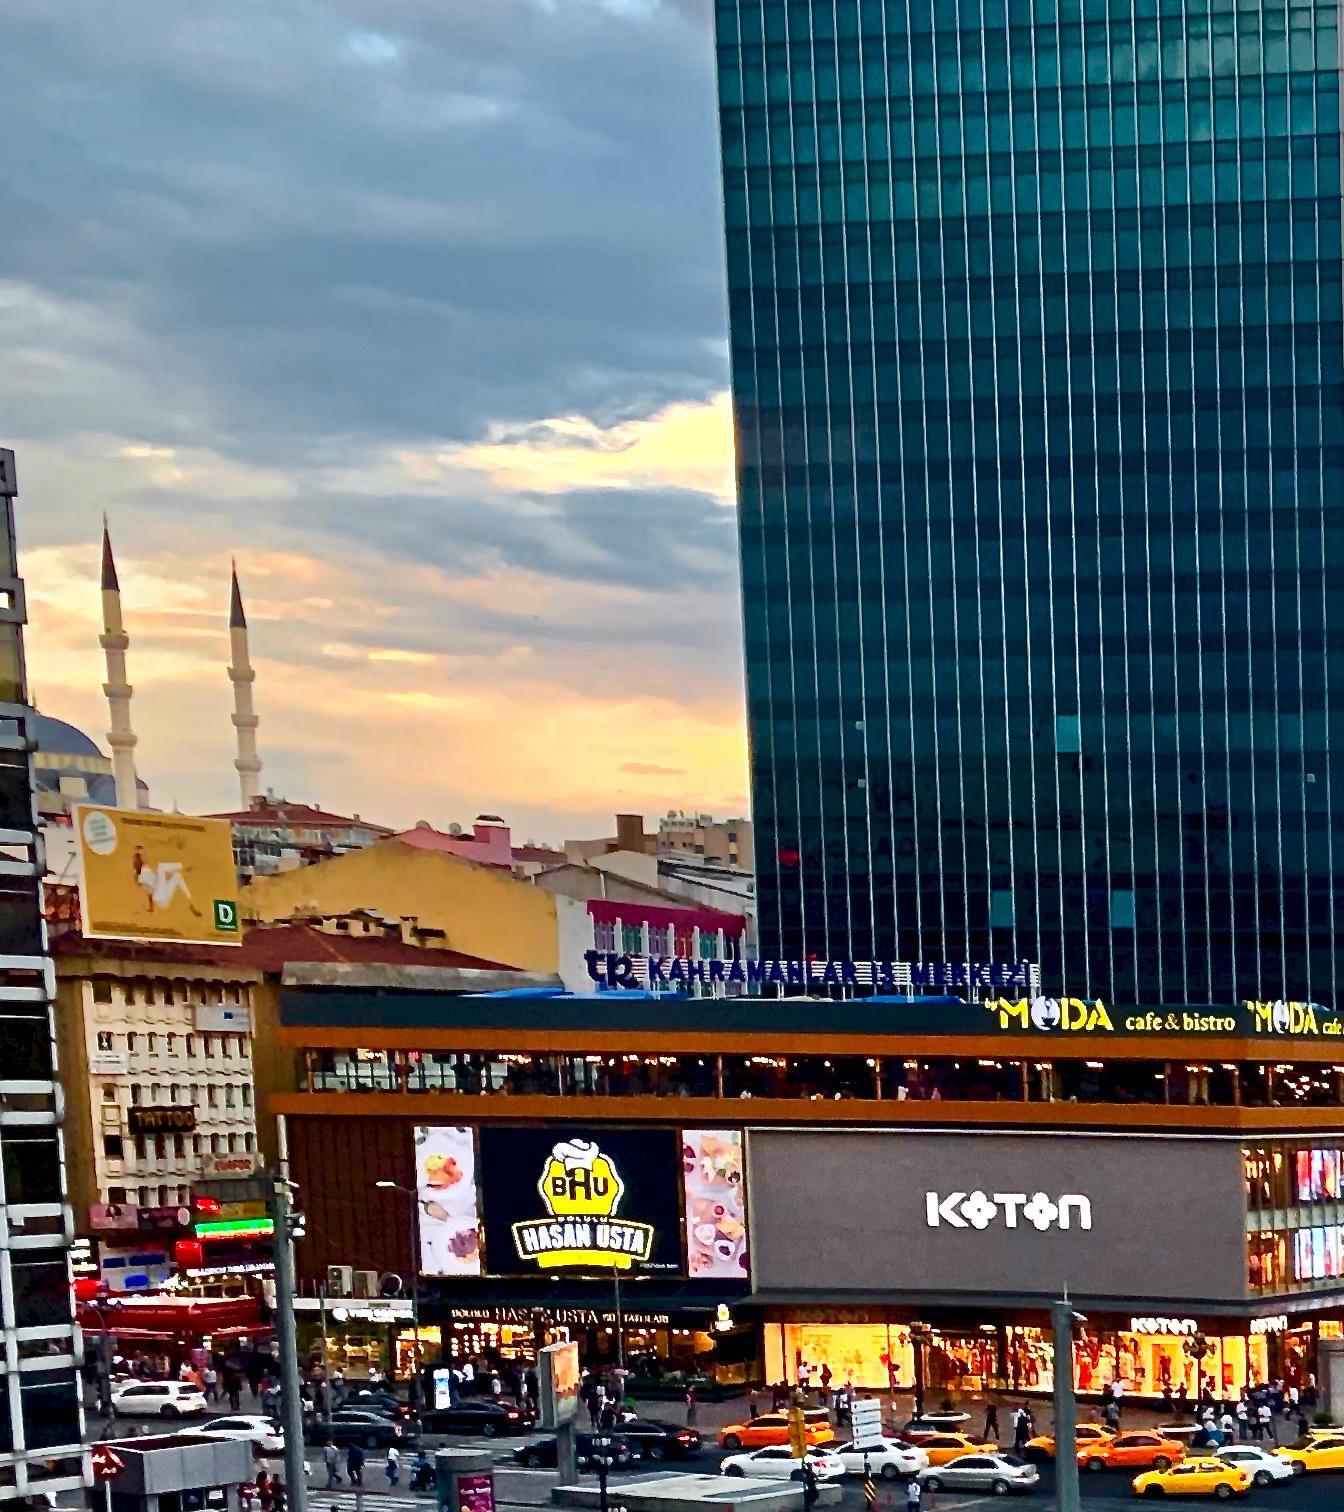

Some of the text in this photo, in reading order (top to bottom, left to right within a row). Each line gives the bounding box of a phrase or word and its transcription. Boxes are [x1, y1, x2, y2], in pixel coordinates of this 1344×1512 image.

[649, 959, 859, 985] KAHRAMANLAR
[999, 996, 1114, 1031] MODA
[1125, 1012, 1162, 1032] cafe
[1165, 1014, 1178, 1031] &
[1183, 1012, 1236, 1032] bistro
[1255, 999, 1318, 1035] MODA
[136, 1110, 194, 1127] TATTOO
[551, 1167, 609, 1201] BHU
[926, 1190, 1092, 1231] KOTON
[522, 1223, 645, 1254] HASAN USTA
[556, 1307, 600, 1324] USTA
[1131, 1316, 1198, 1336] KOTON
